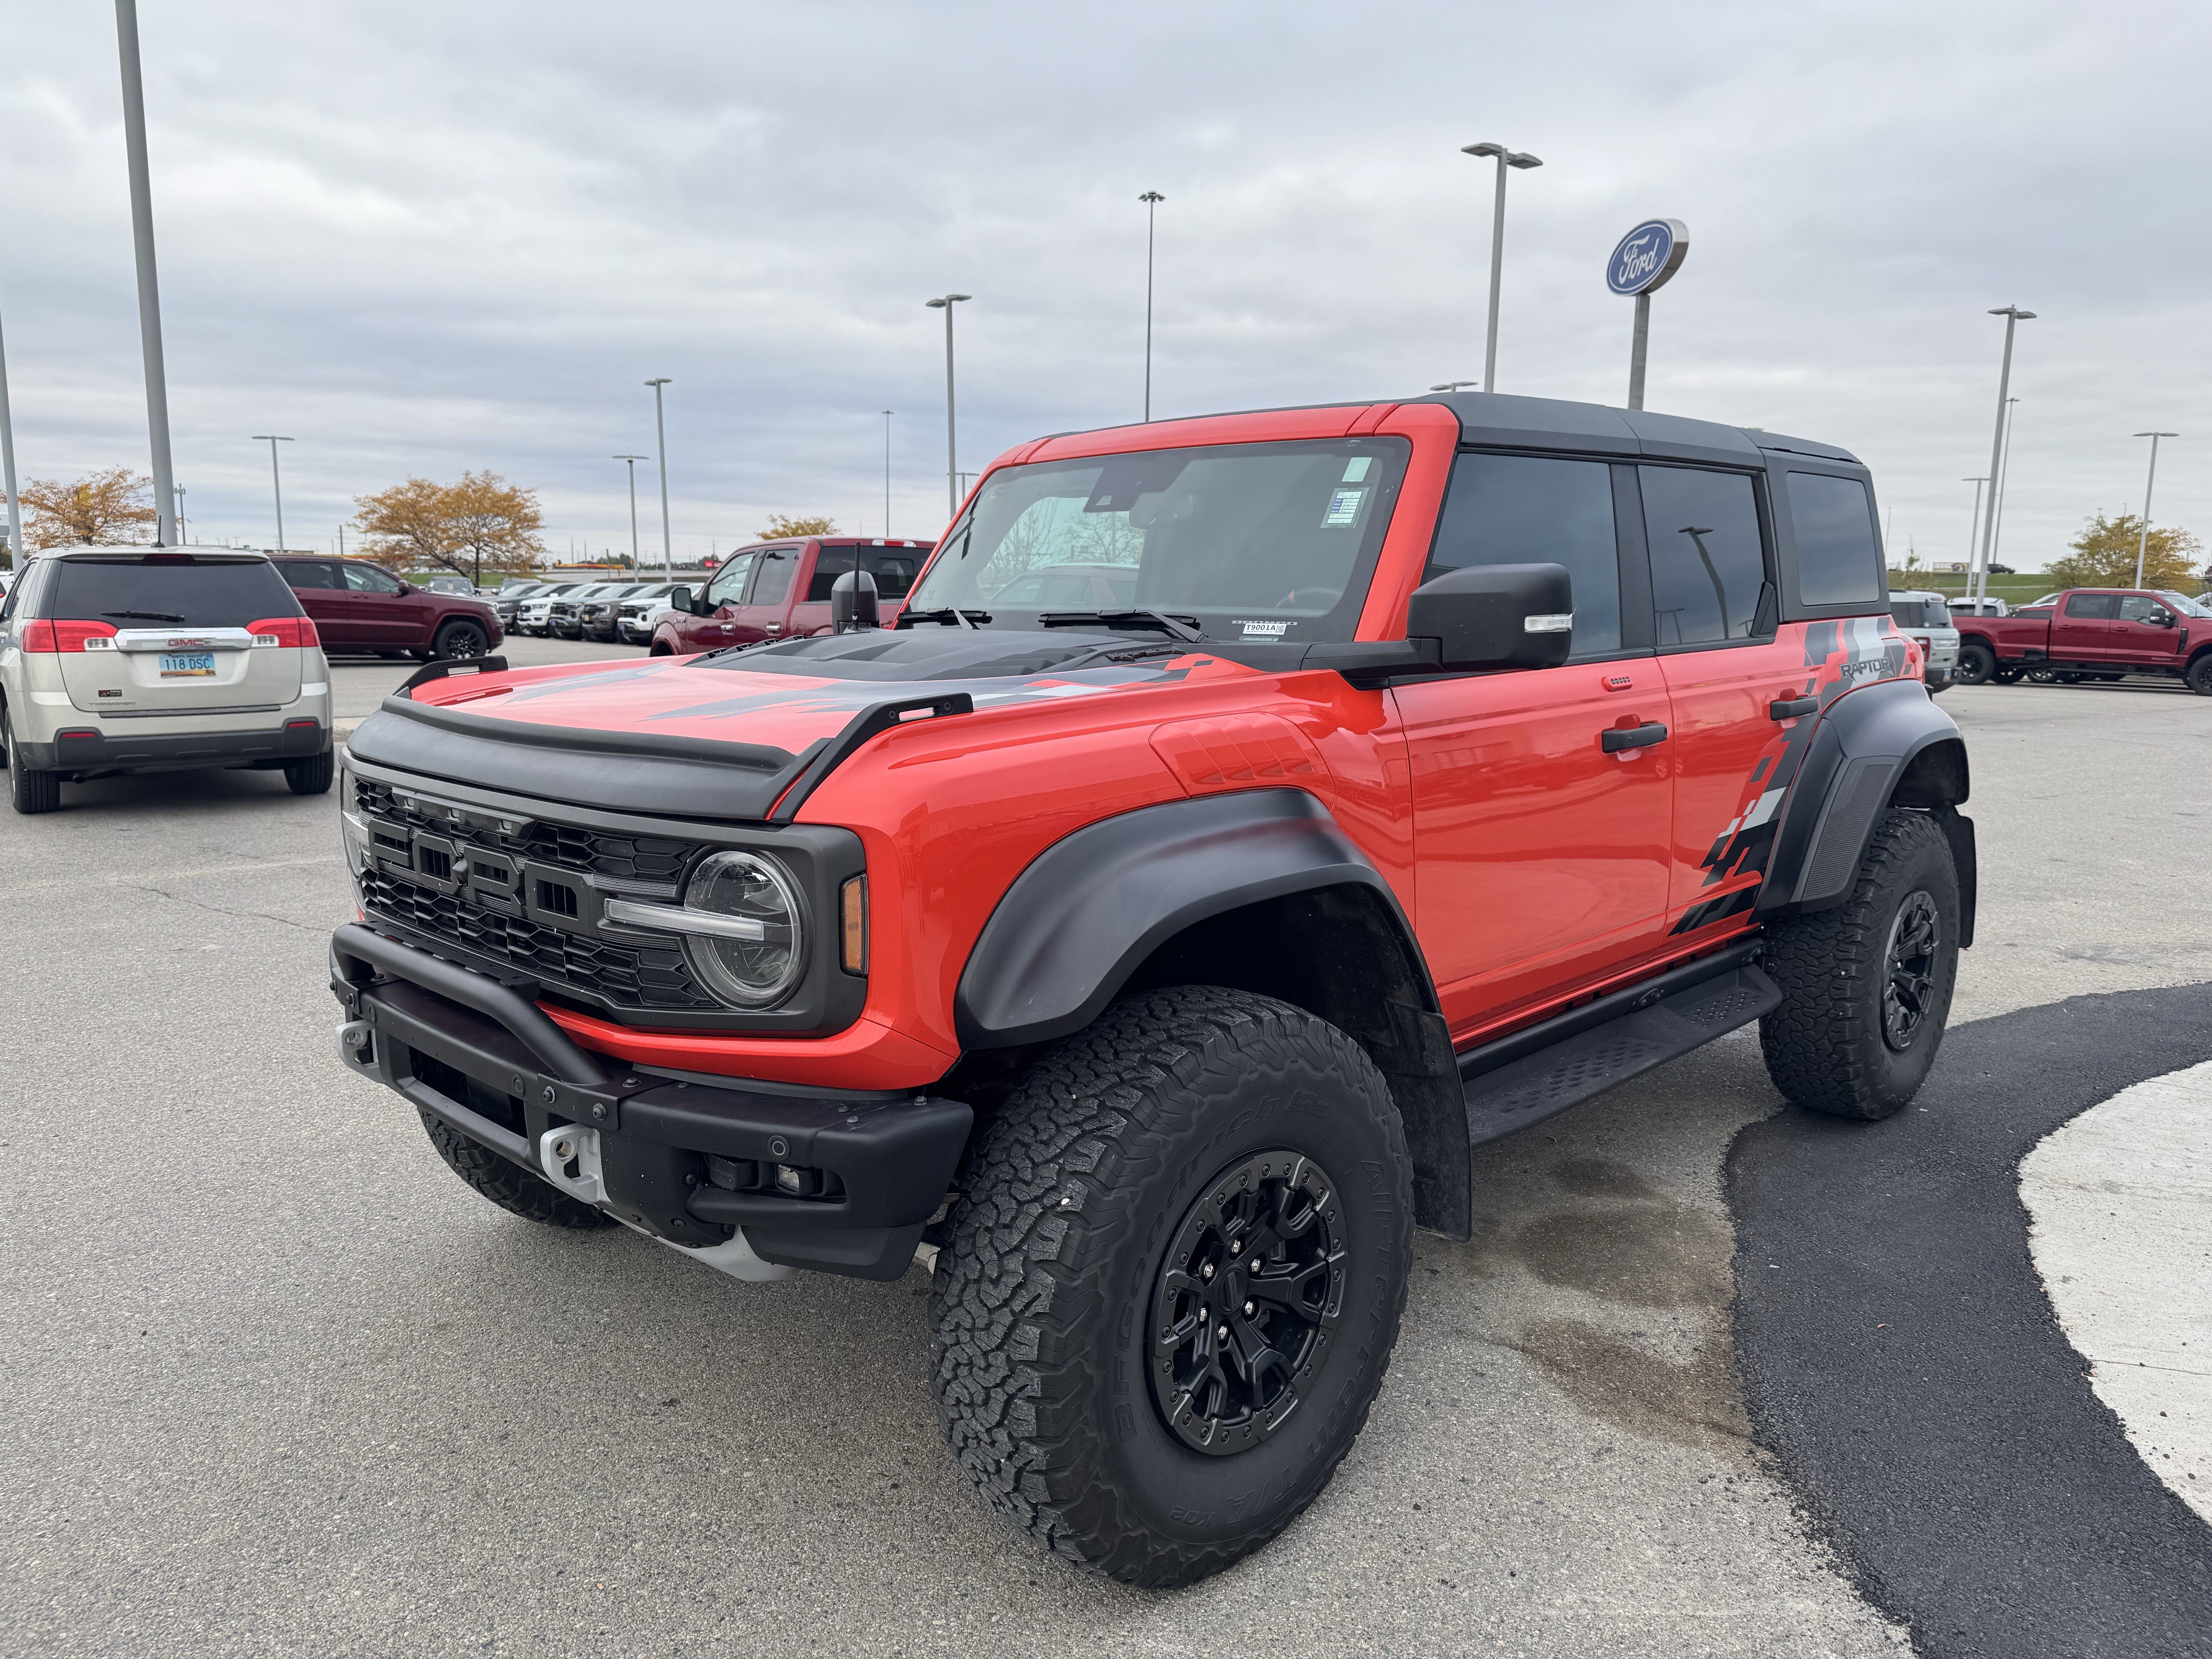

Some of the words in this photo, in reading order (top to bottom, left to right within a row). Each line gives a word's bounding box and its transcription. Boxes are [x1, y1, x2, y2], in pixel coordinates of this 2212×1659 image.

[1618, 234, 1660, 285] Ford
[165, 659, 185, 670] 118
[189, 658, 210, 670] DSC
[1839, 658, 1894, 683] RAPTOR
[368, 816, 599, 938] FORD
[1113, 1096, 1281, 1443] BFGoodrich
[1307, 1160, 1395, 1463] All-Terrain
